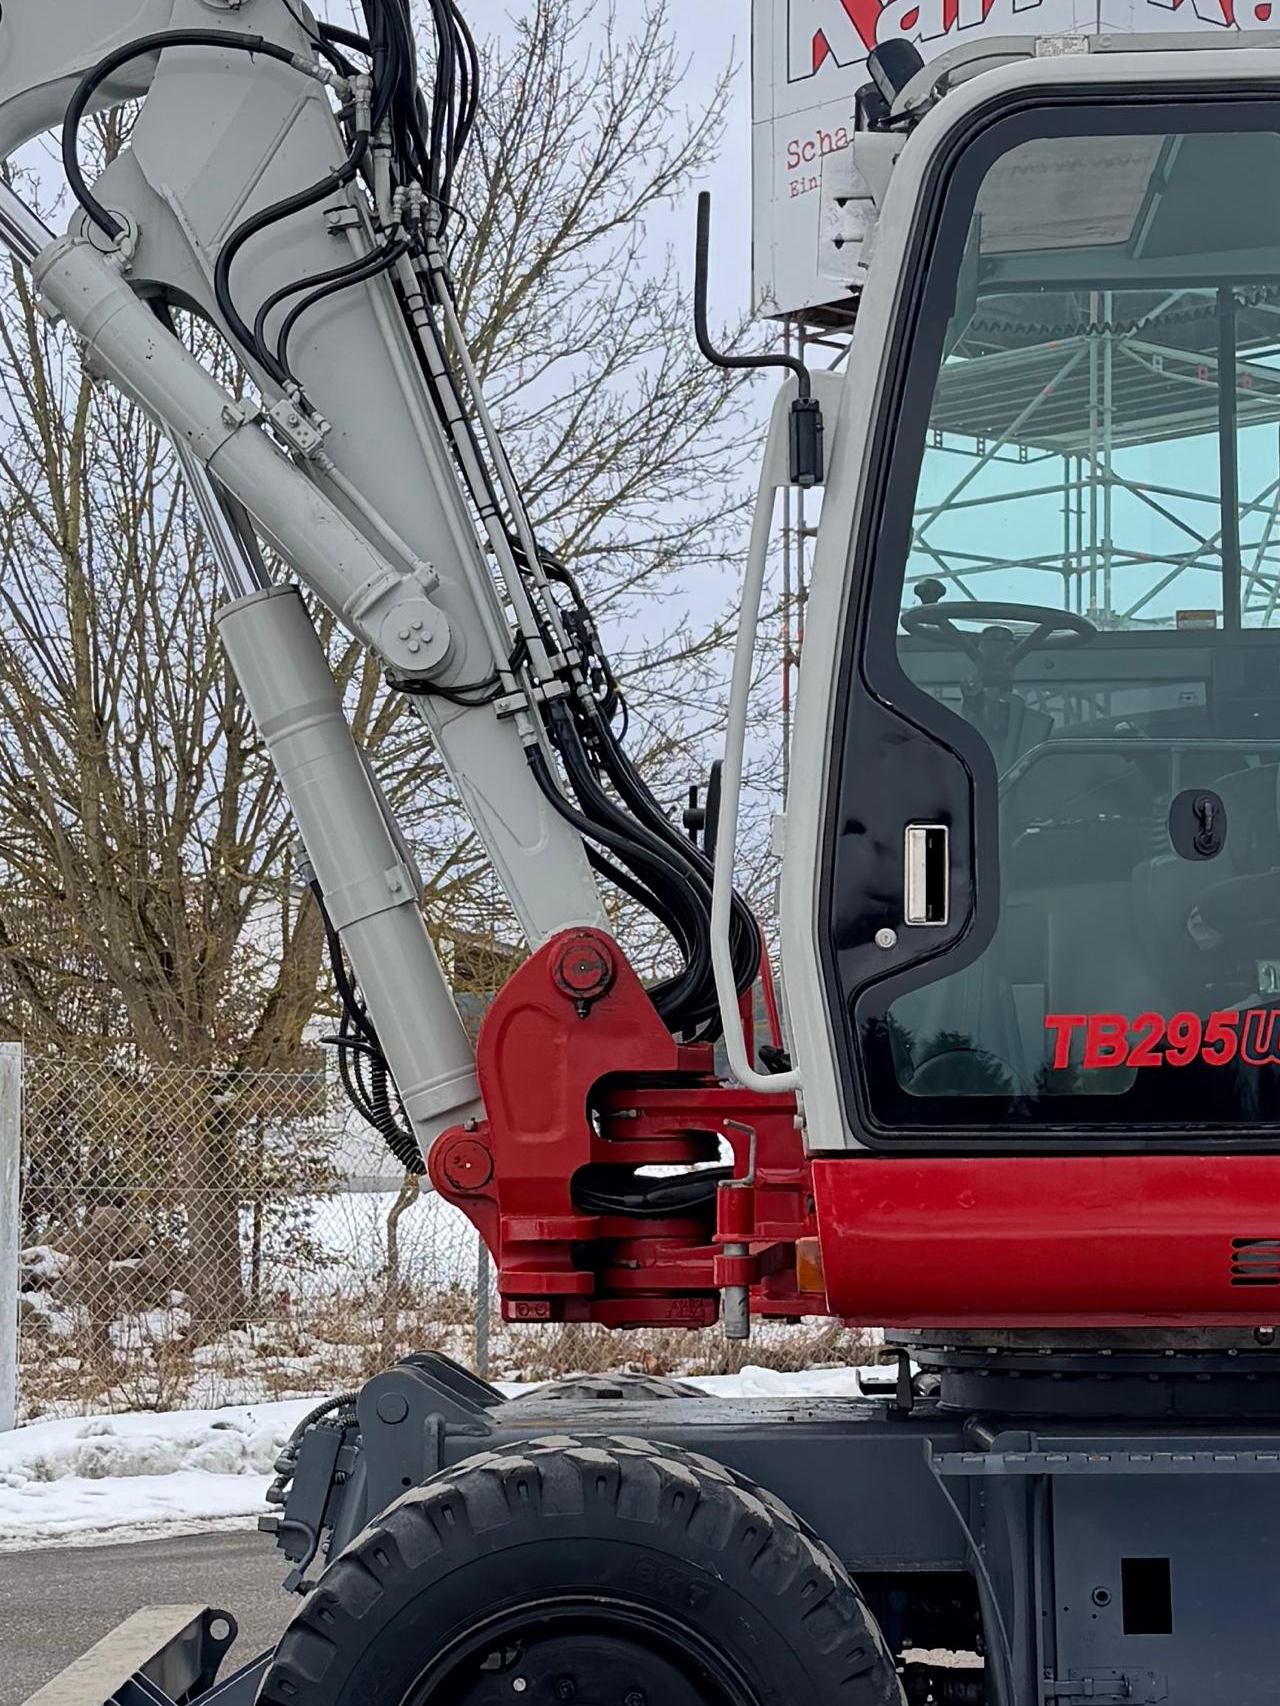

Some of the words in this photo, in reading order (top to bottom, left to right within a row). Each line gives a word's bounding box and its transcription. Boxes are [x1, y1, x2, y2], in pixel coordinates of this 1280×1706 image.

[787, 127, 854, 171] Scha
[789, 174, 822, 199] Ein
[631, 1554, 718, 1607] BKT
